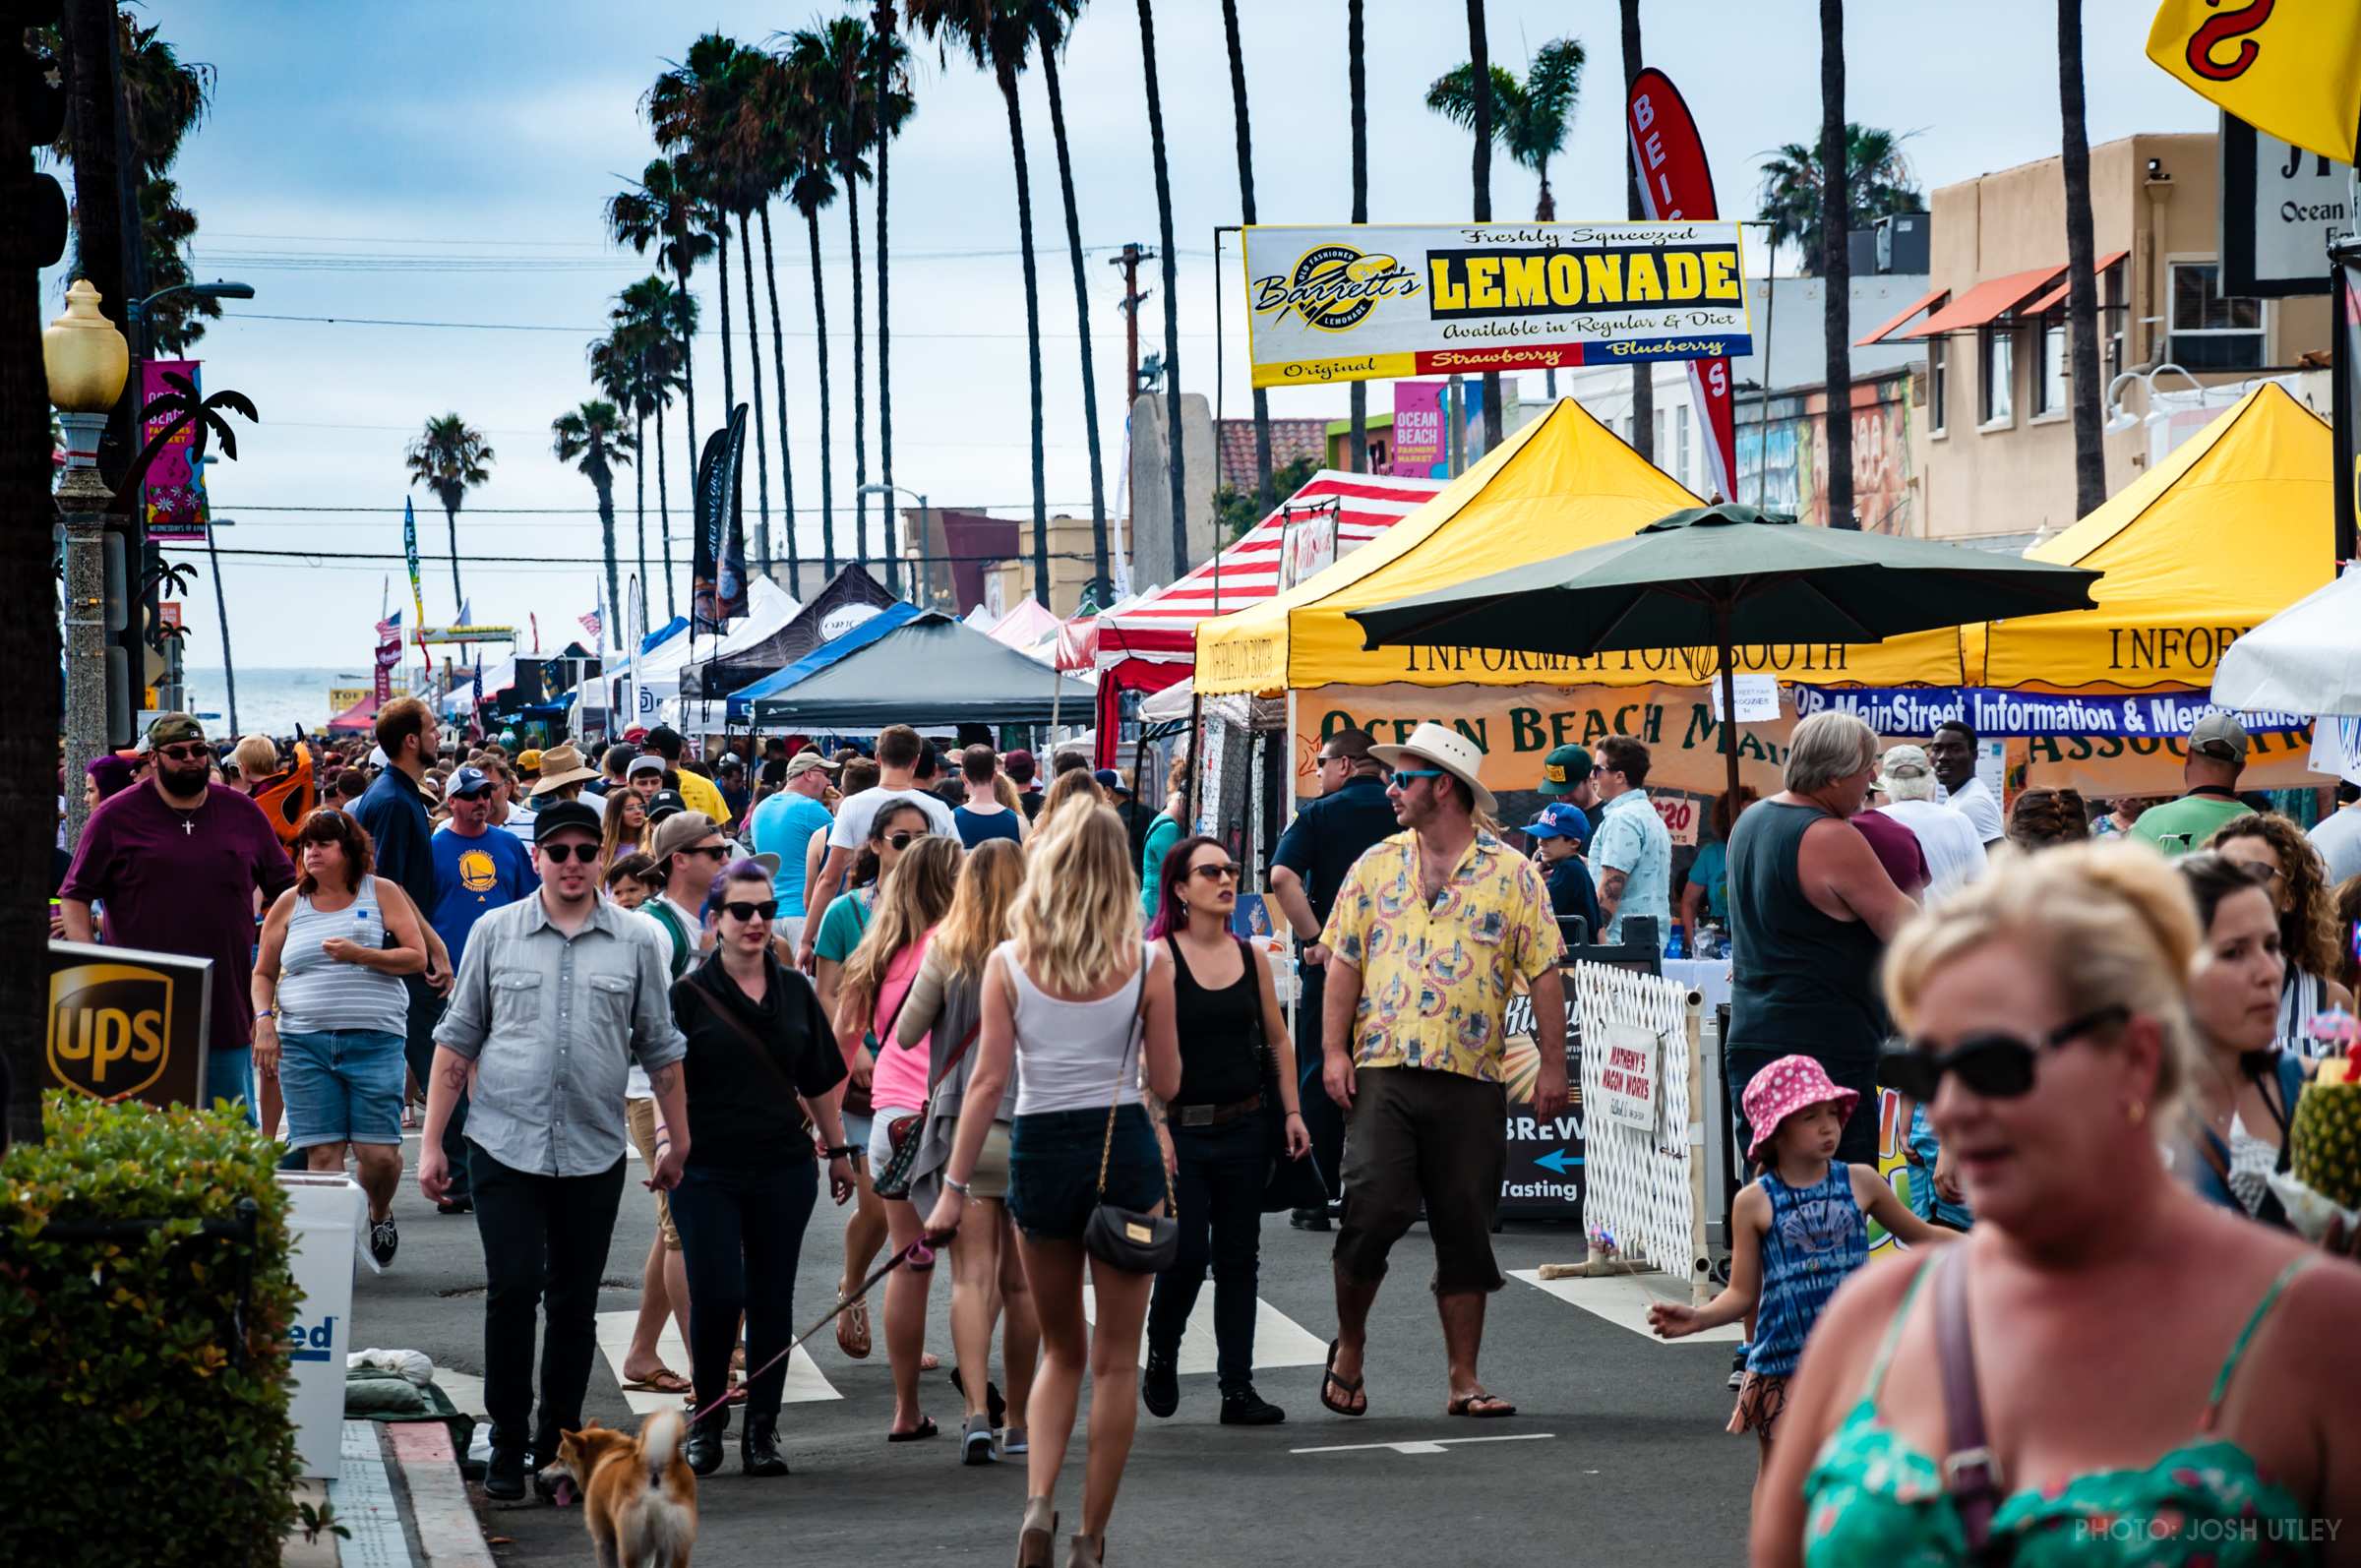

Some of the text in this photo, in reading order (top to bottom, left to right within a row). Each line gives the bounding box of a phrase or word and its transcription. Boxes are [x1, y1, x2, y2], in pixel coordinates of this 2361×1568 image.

[2280, 201, 2344, 223] Ocean
[1461, 226, 1699, 248] Freshly Squeezed
[1298, 250, 1355, 281] OLD FASHIONED
[1253, 266, 1422, 311] Barrett's
[1430, 251, 1740, 311] LEMONADE
[1324, 304, 1367, 326] LEMONADE
[1443, 311, 1736, 339] Available in Regular & Diet
[1430, 349, 1563, 368] Strawberry
[1605, 339, 1726, 357] Blueberry
[1284, 357, 1377, 380] Original
[1397, 411, 1437, 428] OCEAN
[1397, 428, 1437, 445] BEACH
[1794, 684, 1825, 716] OB
[1835, 694, 1967, 734] MainStreet
[1974, 693, 2117, 734] Information
[2123, 699, 2146, 734] &
[1320, 709, 1489, 755] OCEN
[1509, 703, 1664, 753] BEACH
[57, 1007, 162, 1082] ups
[1609, 1046, 1647, 1074] MATHENY'S
[1602, 1068, 1650, 1101] WAGON WORKS
